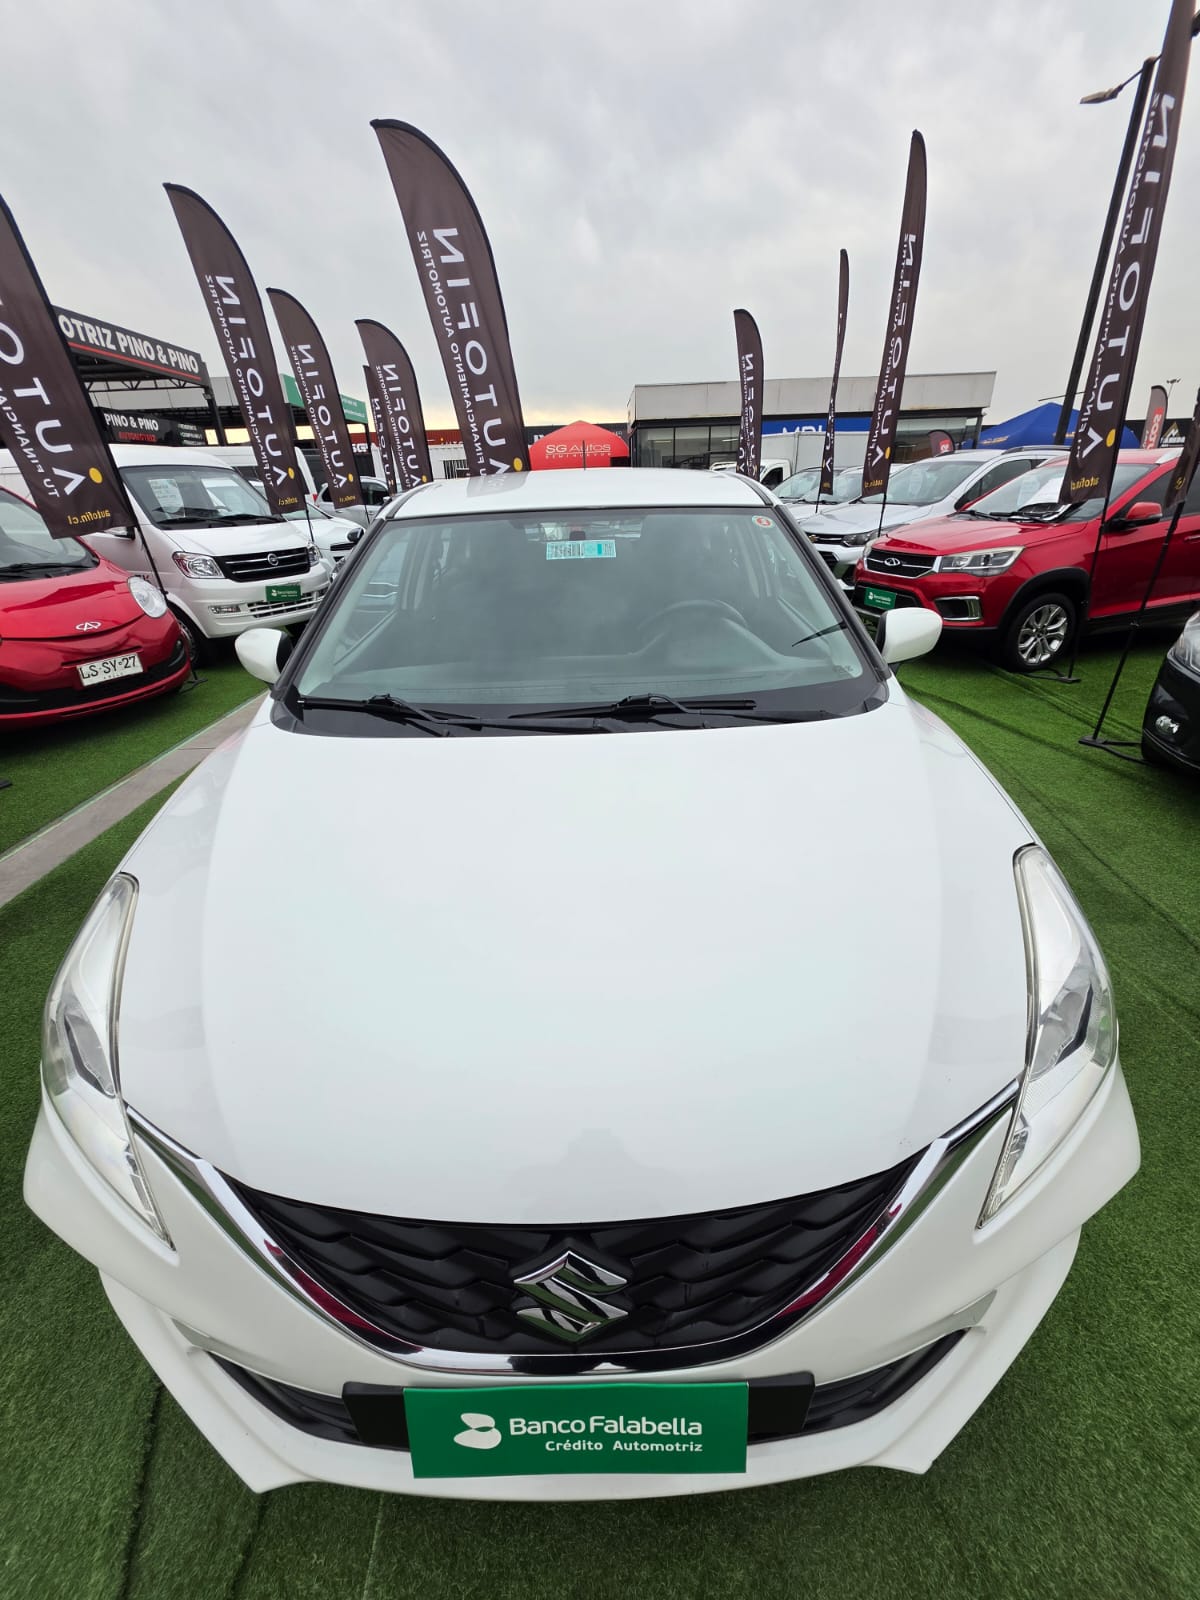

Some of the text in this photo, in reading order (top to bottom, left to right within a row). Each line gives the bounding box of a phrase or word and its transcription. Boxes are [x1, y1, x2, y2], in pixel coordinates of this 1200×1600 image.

[115, 331, 156, 361] PINO
[156, 344, 169, 364] &
[167, 348, 199, 374] PINO
[104, 412, 160, 431] PINO & PINO
[545, 442, 611, 454] SG Autos
[508, 1415, 703, 1437] Banco Falabella
[545, 1439, 703, 1453] Crédito Automotriz
